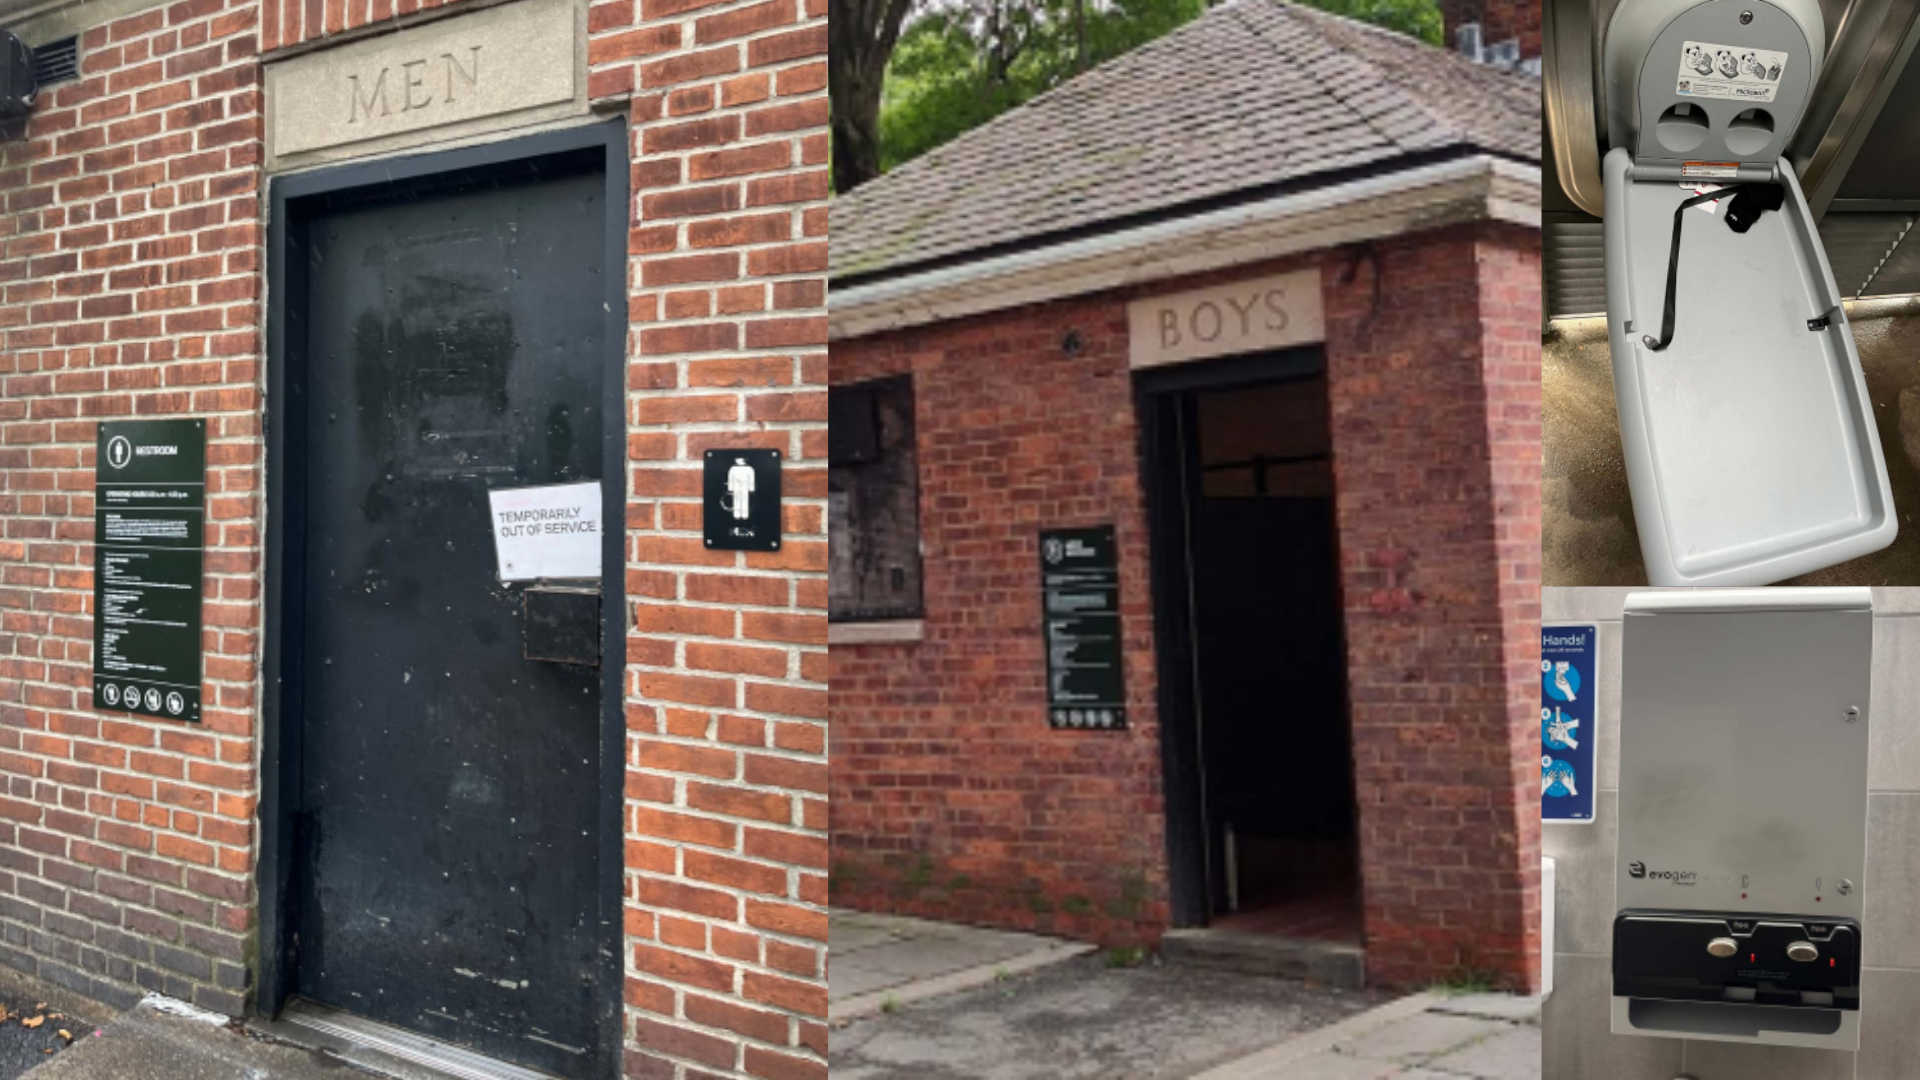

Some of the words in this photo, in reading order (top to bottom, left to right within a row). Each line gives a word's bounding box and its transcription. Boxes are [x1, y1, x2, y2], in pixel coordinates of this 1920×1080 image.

[347, 45, 483, 124] MEN
[1159, 289, 1289, 350] BOYS
[498, 507, 580, 524] TEMPORARILY
[500, 524, 525, 538] OUT
[526, 522, 542, 536] OF
[544, 520, 597, 534] SERVICE
[1542, 633, 1586, 646] Hands!
